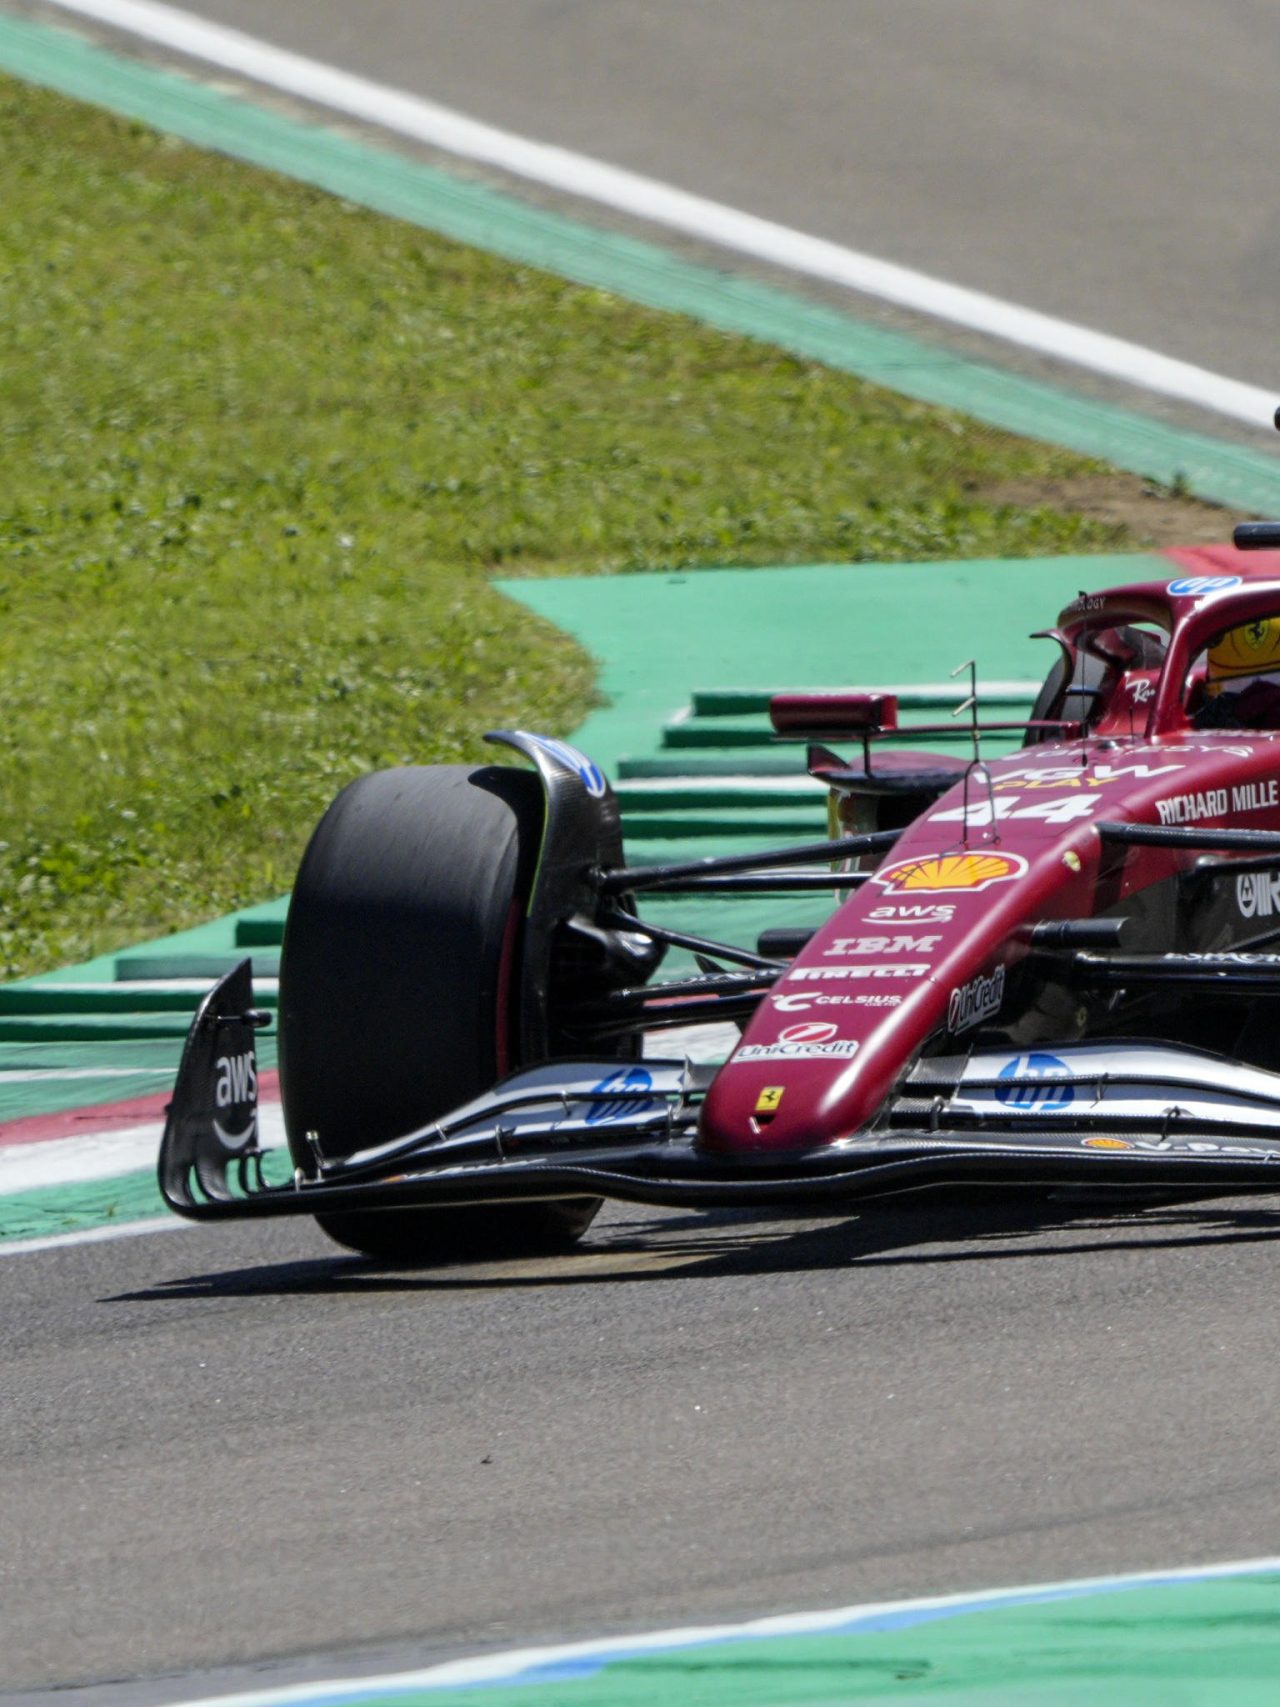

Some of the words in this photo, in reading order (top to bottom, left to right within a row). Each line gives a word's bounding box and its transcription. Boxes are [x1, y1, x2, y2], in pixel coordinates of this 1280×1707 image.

[973, 764, 1187, 784] VGW
[991, 777, 1120, 791] PLAY
[927, 793, 1103, 827] 44
[1155, 792, 1228, 825] RICHARD
[1232, 780, 1279, 812] MILLE
[868, 905, 957, 918] aws
[823, 935, 943, 956] IBM
[787, 963, 932, 981] PIRELLI
[815, 995, 902, 1005] CELSIUS
[738, 1042, 855, 1057] UniCredit
[216, 1050, 257, 1107] aws
